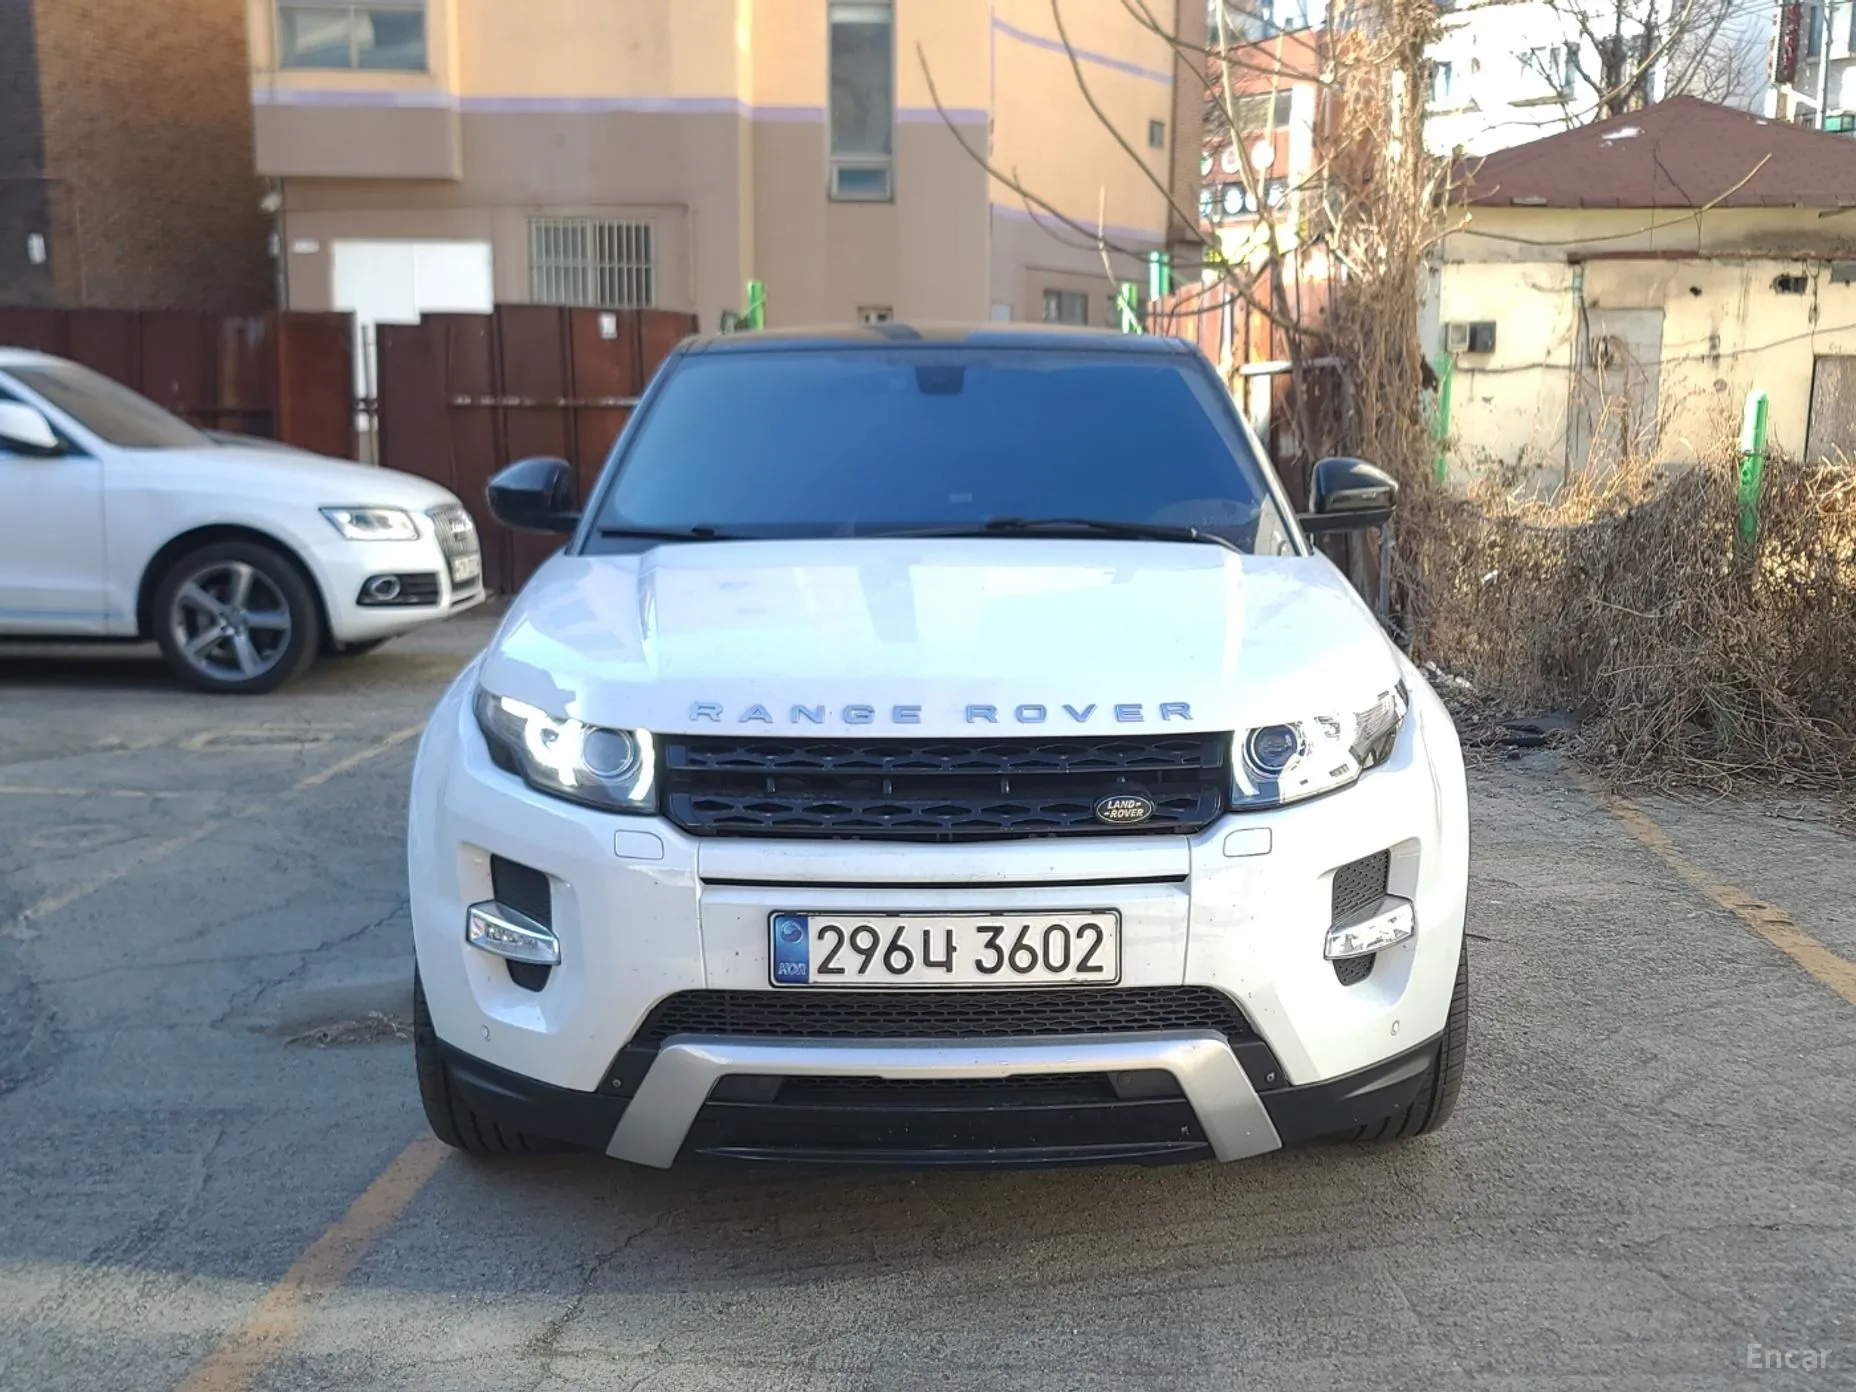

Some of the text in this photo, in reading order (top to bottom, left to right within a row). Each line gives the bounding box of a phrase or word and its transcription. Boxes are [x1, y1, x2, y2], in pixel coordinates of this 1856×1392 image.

[689, 701, 1194, 724] RANGE ROVER
[817, 923, 1105, 975] 296나 3602
